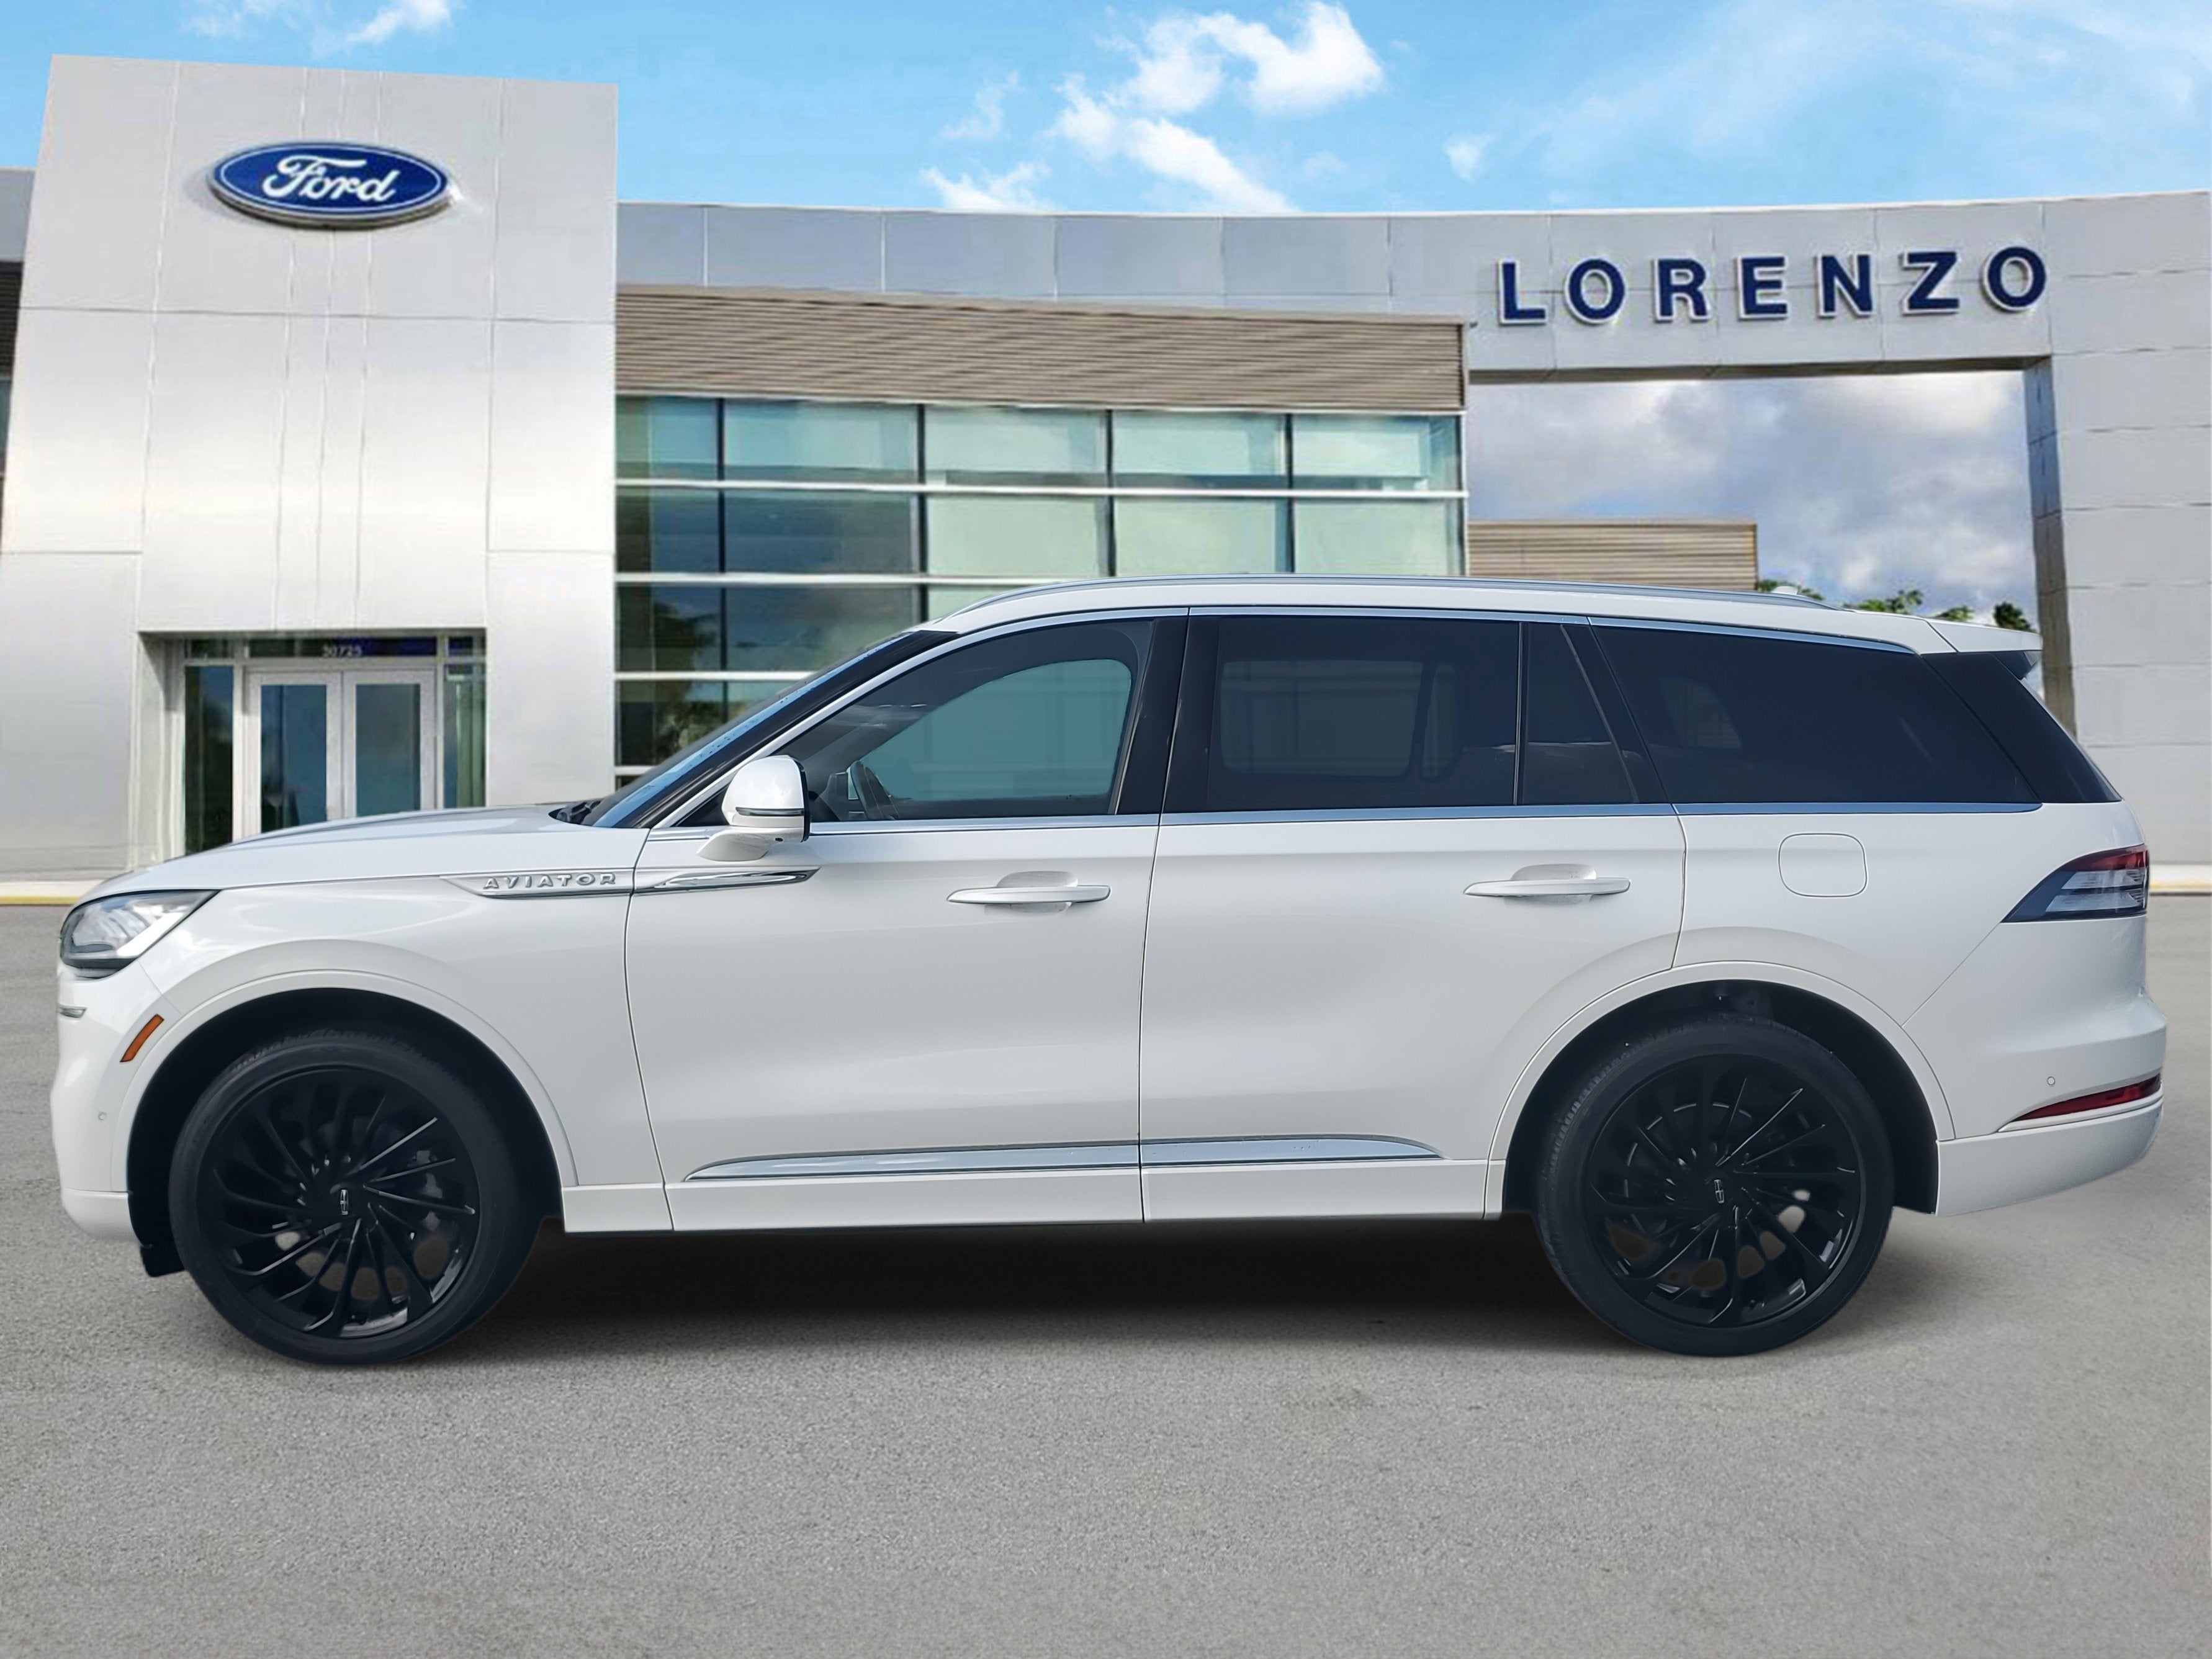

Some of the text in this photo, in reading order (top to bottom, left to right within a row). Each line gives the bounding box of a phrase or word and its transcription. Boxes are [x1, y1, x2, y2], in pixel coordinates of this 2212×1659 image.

[263, 155, 400, 201] Ford
[1499, 246, 2047, 322] LORENZO
[483, 873, 616, 889] AVIATOR
